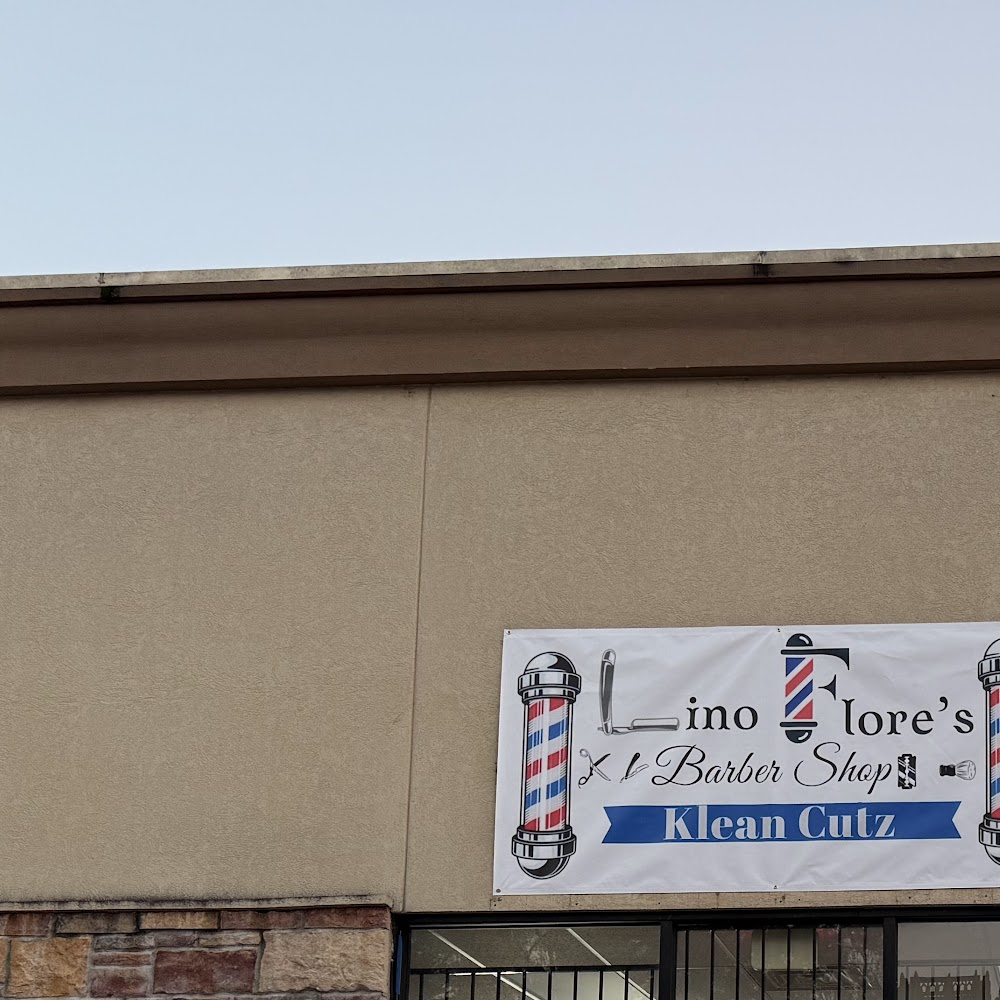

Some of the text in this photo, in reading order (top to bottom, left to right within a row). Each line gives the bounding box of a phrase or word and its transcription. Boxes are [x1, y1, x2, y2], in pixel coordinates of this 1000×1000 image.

[598, 633, 974, 743] Lino Flore's
[651, 741, 892, 795] Barber Shop
[663, 804, 895, 841] Klean Cutz
